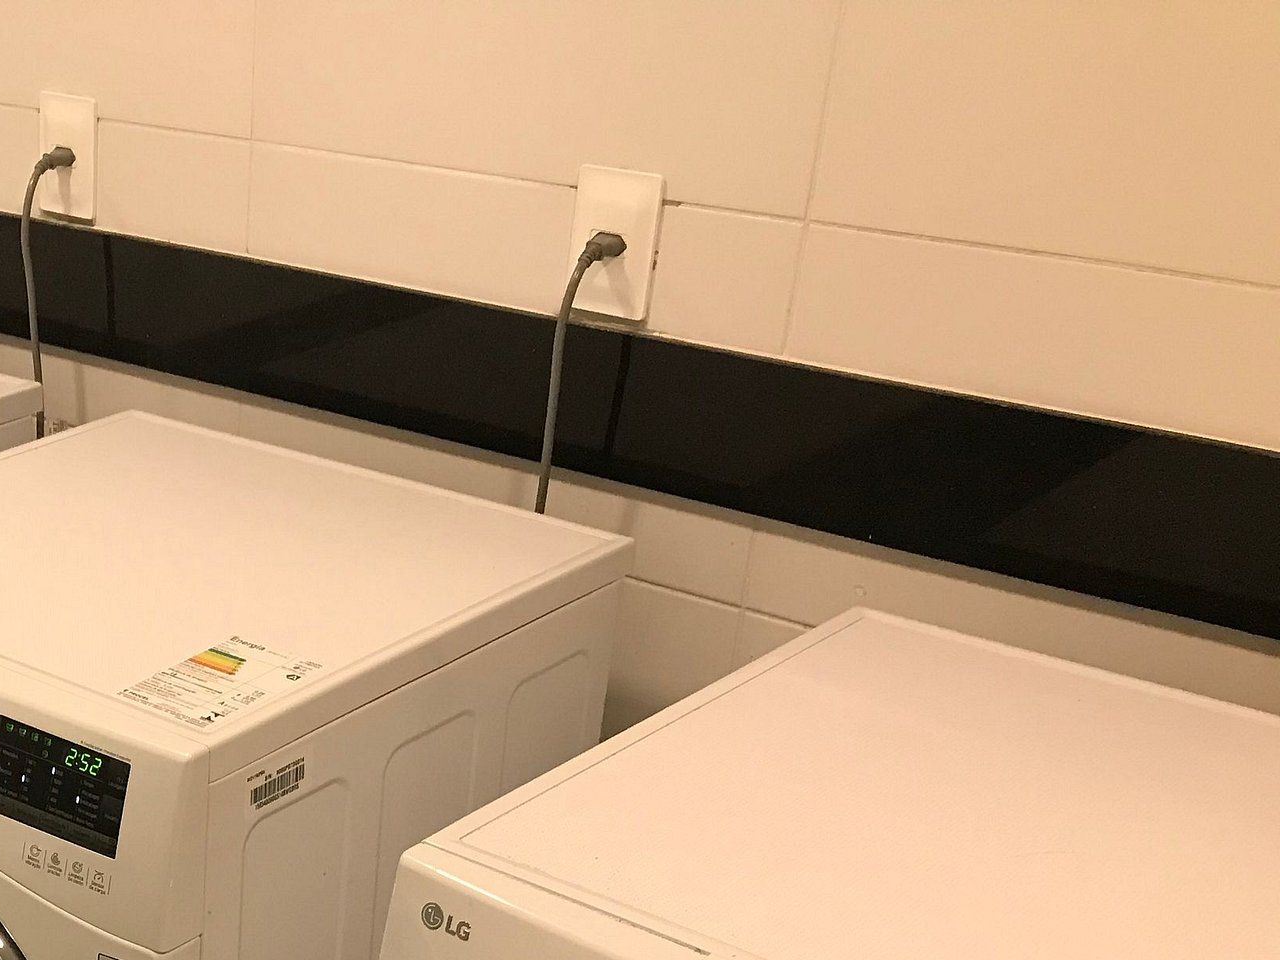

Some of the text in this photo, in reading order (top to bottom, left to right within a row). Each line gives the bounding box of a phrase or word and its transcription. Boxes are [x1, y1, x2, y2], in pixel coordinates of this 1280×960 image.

[230, 636, 266, 651] Energia
[64, 748, 103, 776] 2:52
[445, 915, 471, 942] LG
